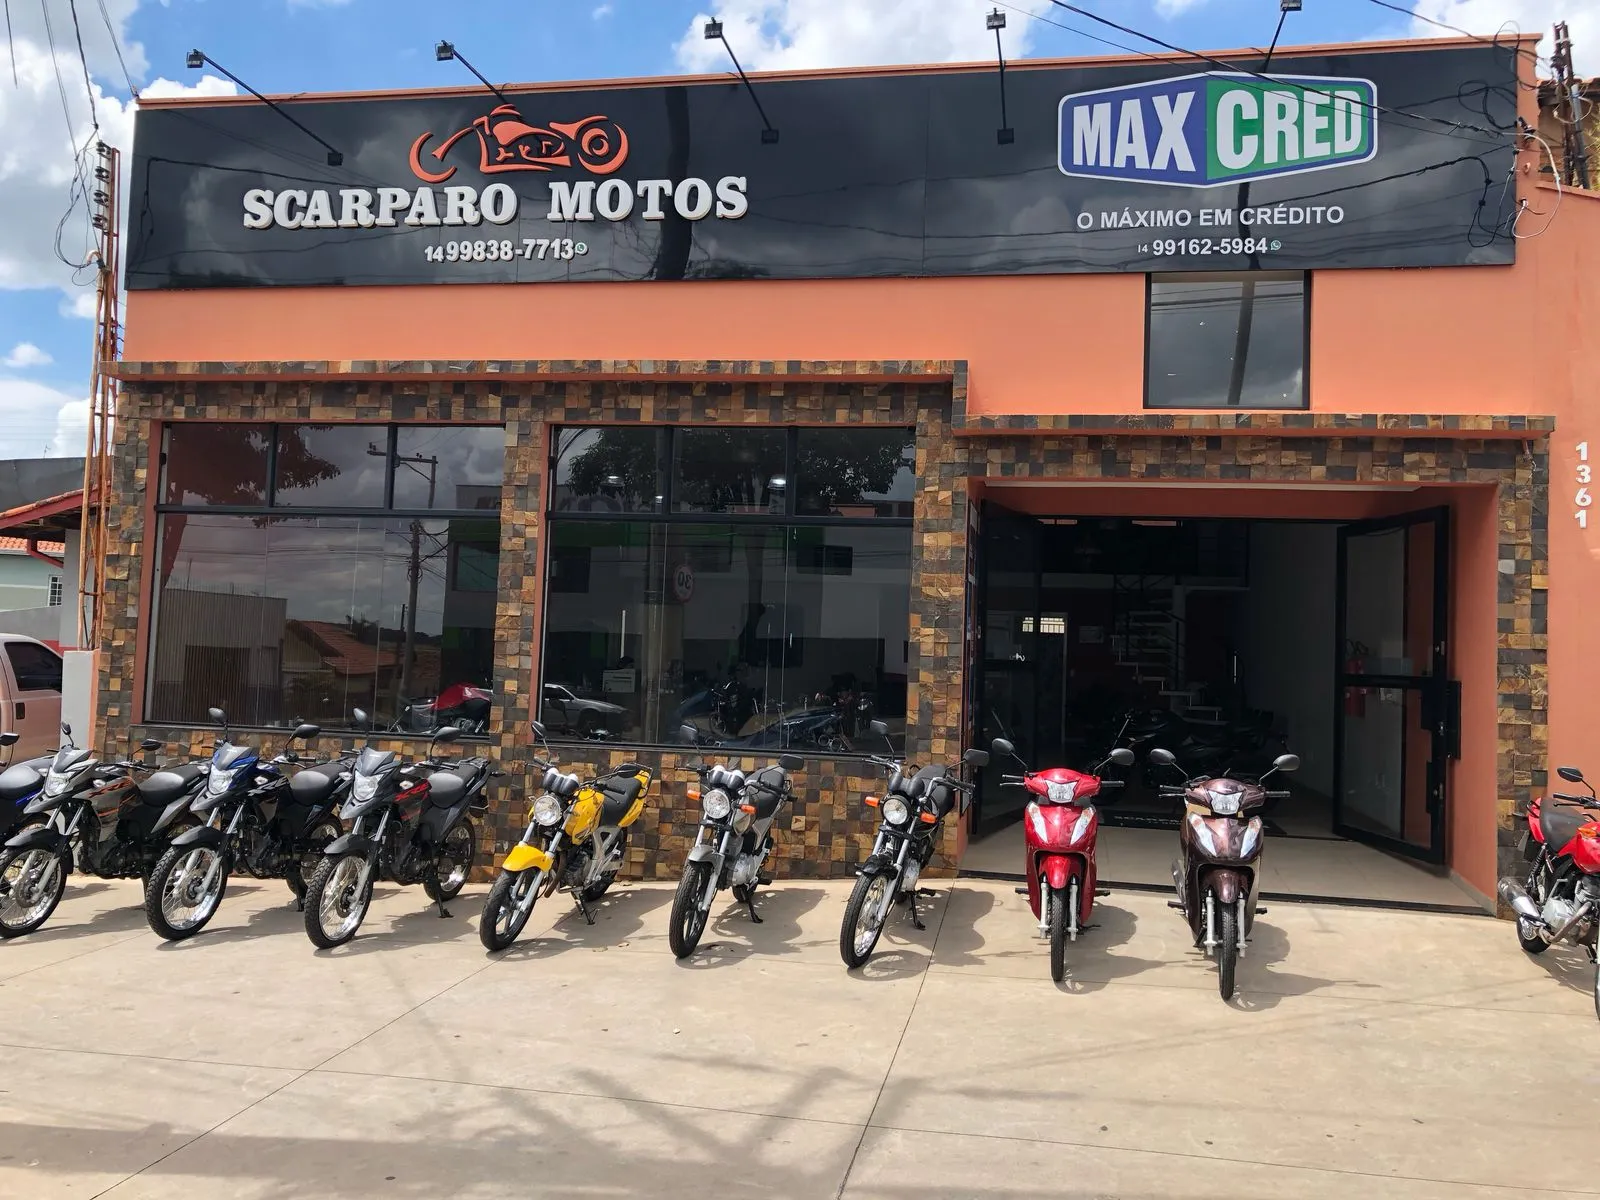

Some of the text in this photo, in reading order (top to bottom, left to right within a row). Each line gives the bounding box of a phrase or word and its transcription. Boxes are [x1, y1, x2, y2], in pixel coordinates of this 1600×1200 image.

[1073, 89, 1362, 172] MAX CRED
[243, 175, 748, 230] SCARPARO MOTOS
[1076, 203, 1345, 230] O MÁXIMO EM CRÉDITO
[1137, 237, 1268, 256] 14 99162-5984
[1574, 441, 1593, 529] 1361
